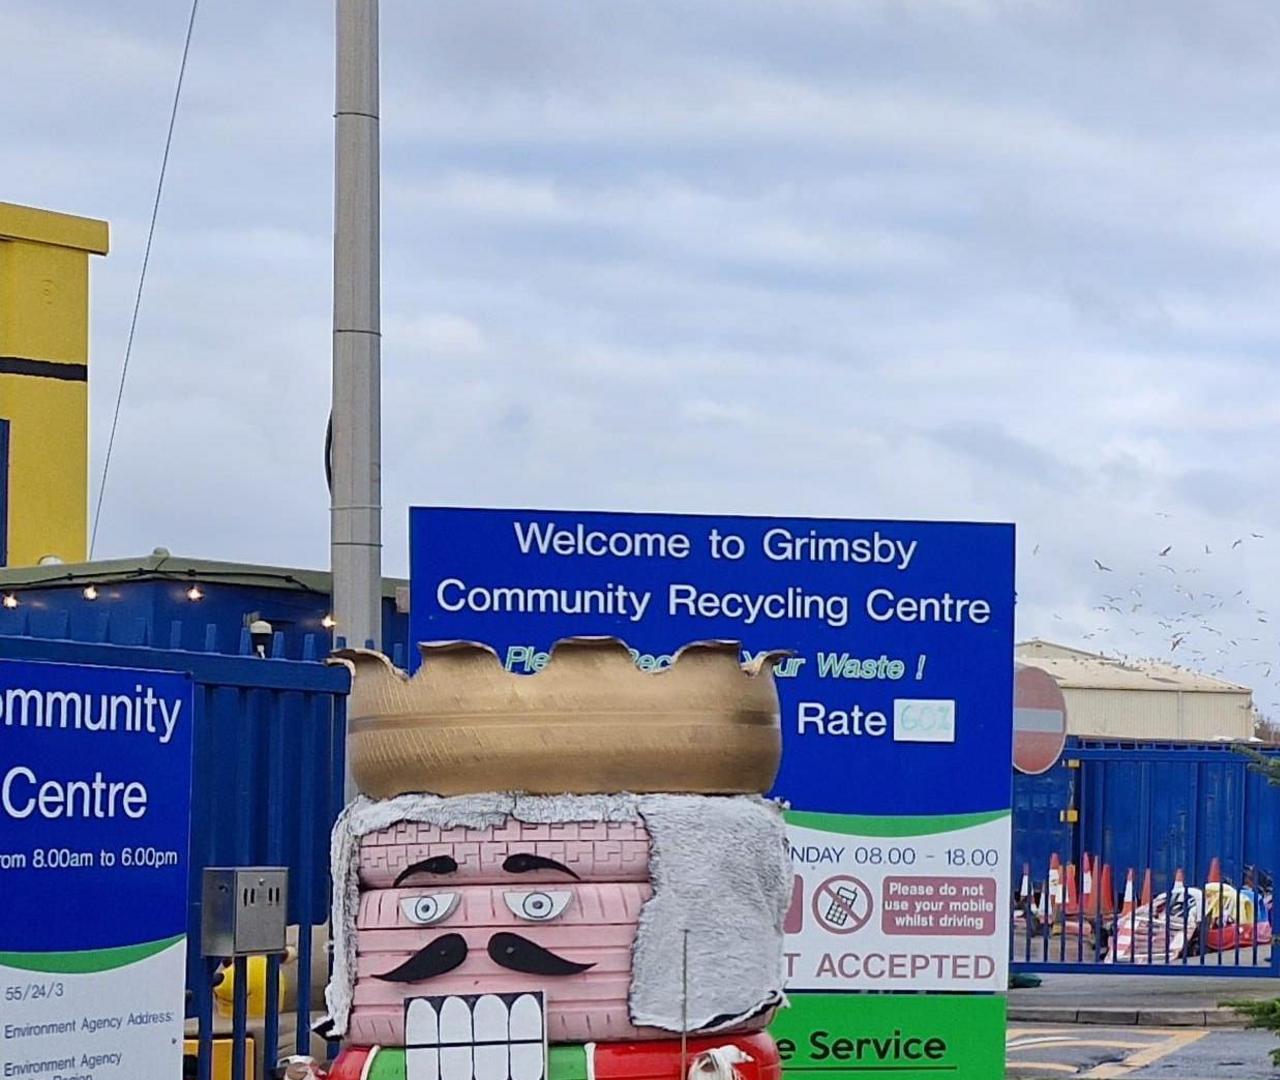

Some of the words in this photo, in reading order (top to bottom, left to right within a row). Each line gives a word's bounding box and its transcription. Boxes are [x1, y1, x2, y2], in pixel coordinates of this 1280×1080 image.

[513, 521, 690, 559] Welcome
[708, 528, 745, 560] to
[762, 527, 918, 571] Grimsby
[436, 578, 651, 622] Community
[668, 583, 848, 627] Recycling
[866, 588, 991, 624] Centre
[816, 652, 905, 680] Waste
[915, 654, 926, 681] !
[0, 684, 182, 744] mmunity
[797, 702, 888, 737] Rate
[2, 766, 148, 819] Centre
[0, 853, 26, 869] om
[32, 848, 94, 869] 8.00am
[100, 849, 116, 867] to
[121, 847, 178, 869] 6.00pm
[787, 846, 846, 864] NDAY
[854, 846, 916, 866] 08.00
[944, 848, 999, 867] 18.00
[889, 881, 934, 897] Please
[939, 882, 957, 897] do
[962, 883, 984, 897] not
[884, 900, 909, 911] use
[914, 900, 944, 914] your
[949, 899, 994, 912] mobile
[895, 914, 933, 927] whilst
[939, 914, 984, 930] driving
[815, 952, 996, 980] ACCEPTED
[5, 982, 65, 1001] 55/24/3
[5, 1020, 76, 1039] Environment
[81, 1016, 123, 1033] Agency
[808, 1029, 947, 1061] Service
[4, 1057, 76, 1077] Environment
[80, 1052, 122, 1069] Agency
